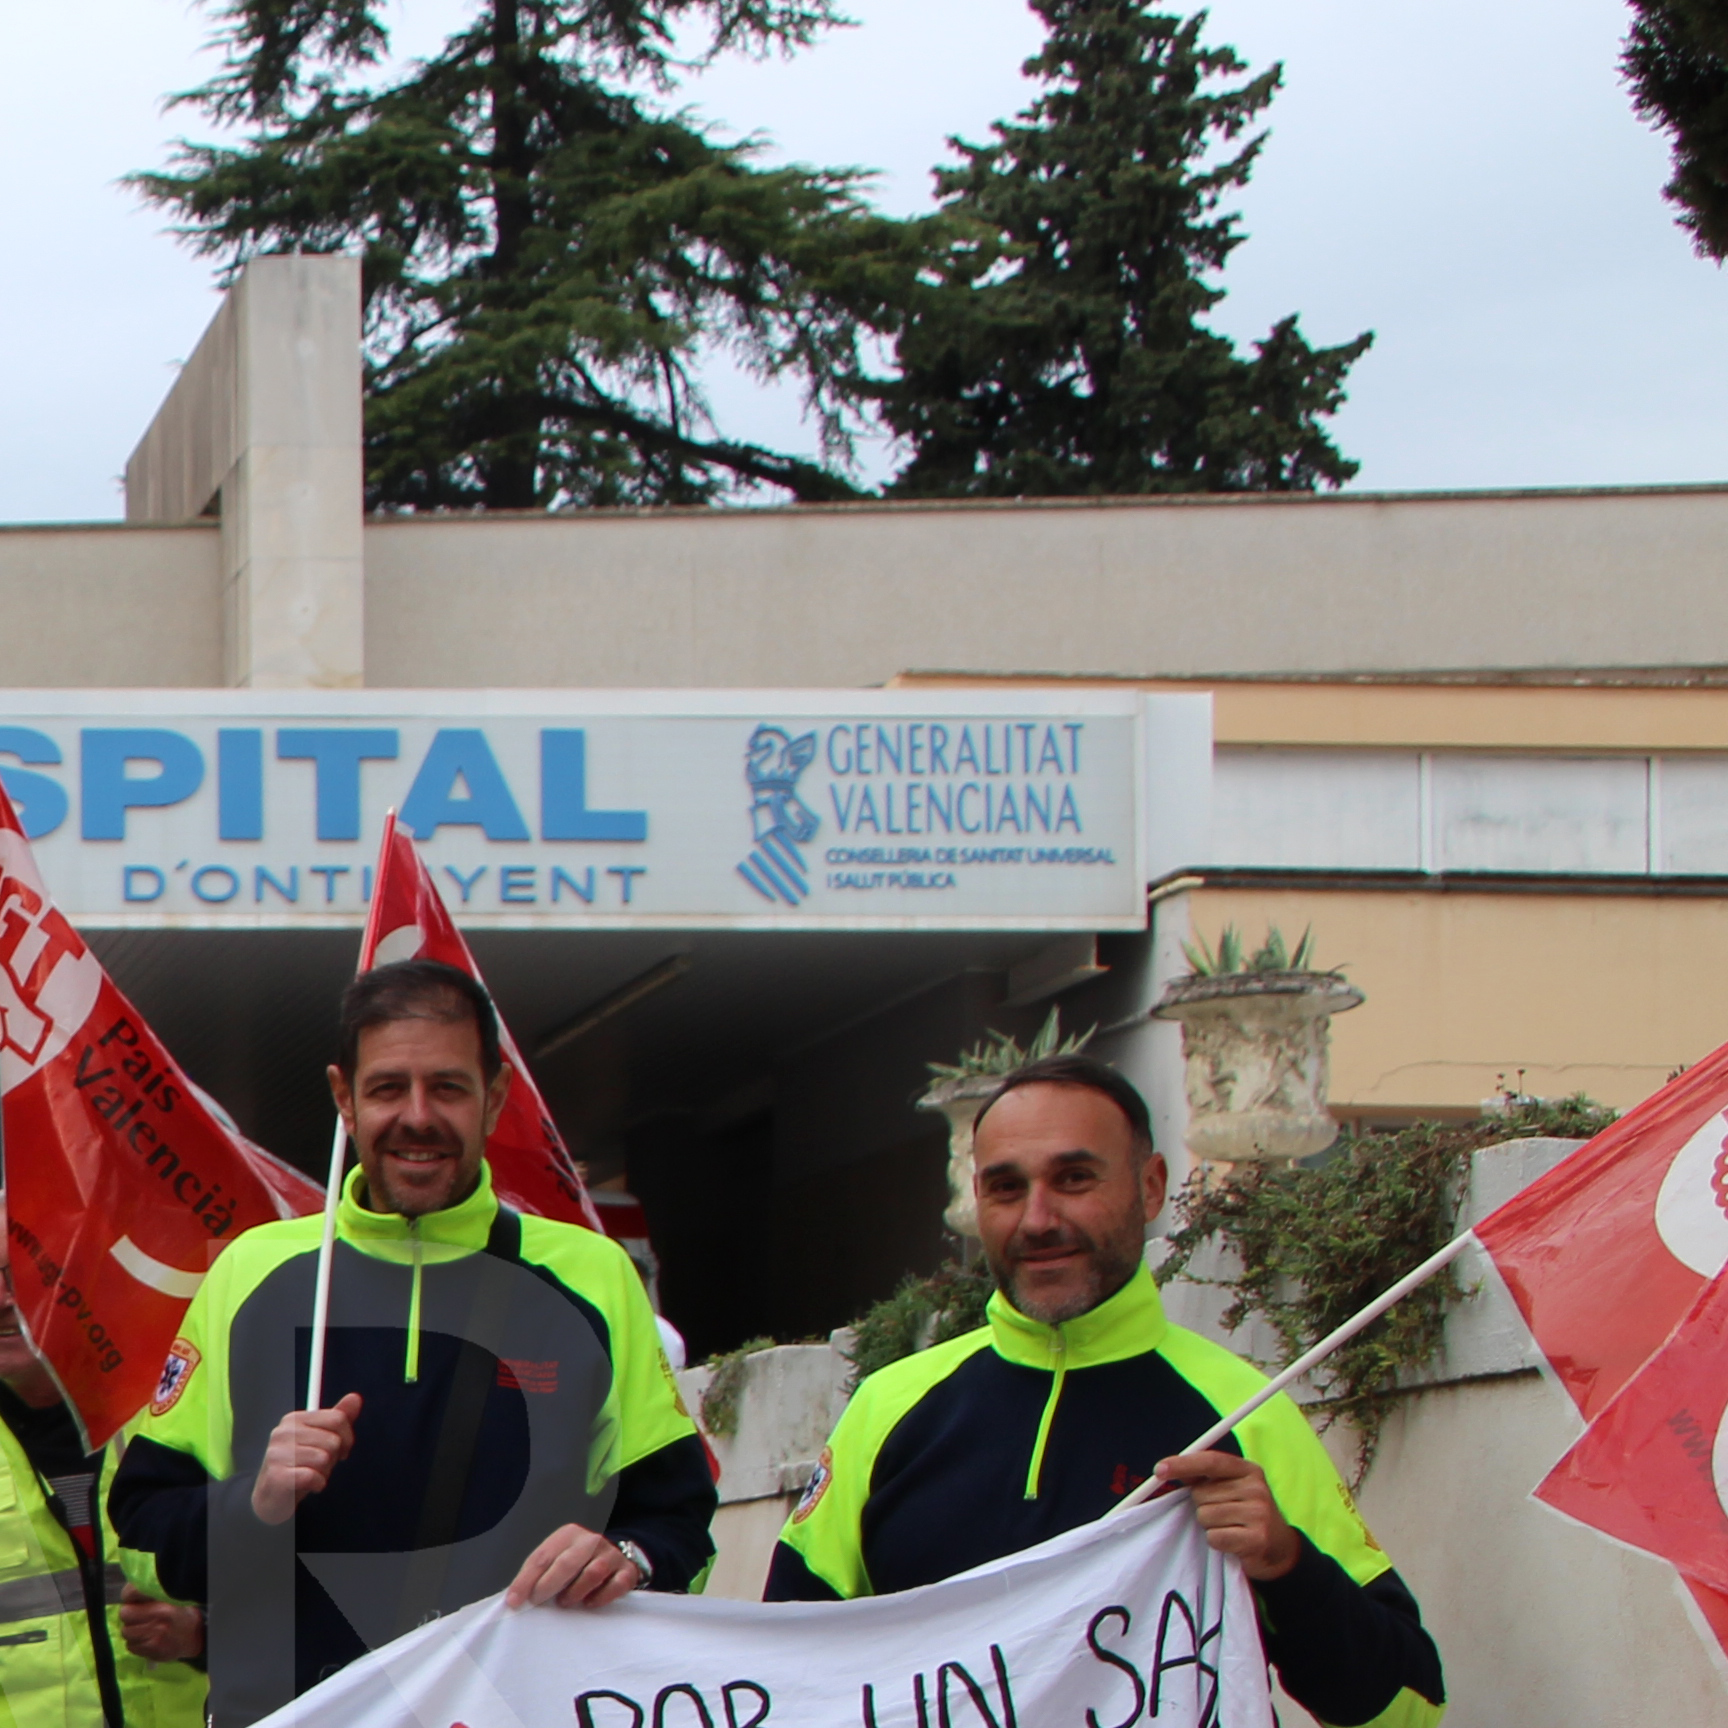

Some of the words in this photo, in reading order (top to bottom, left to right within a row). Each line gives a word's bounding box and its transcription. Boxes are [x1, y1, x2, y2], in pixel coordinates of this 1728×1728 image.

[827, 724, 1083, 774] GENERALITAT
[830, 782, 1082, 833] VALENCIANA
[74, 1045, 237, 1237] Valencià
